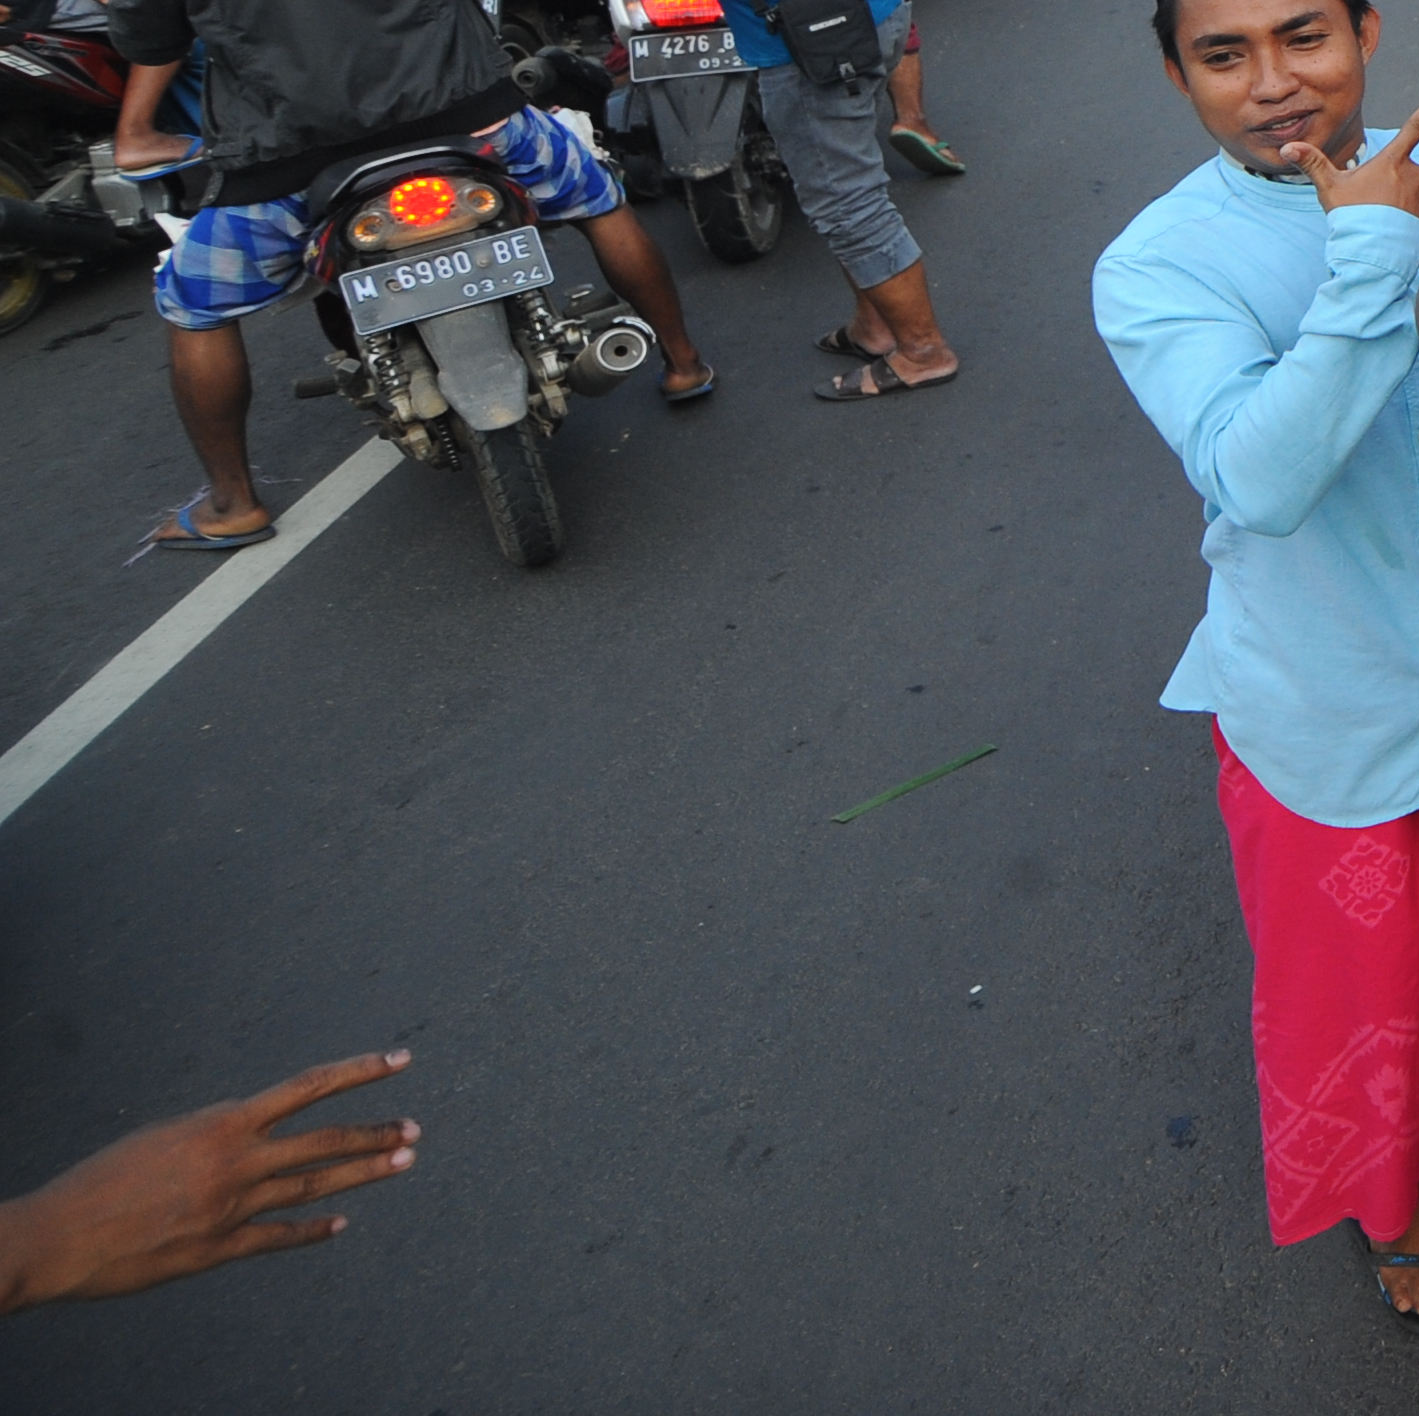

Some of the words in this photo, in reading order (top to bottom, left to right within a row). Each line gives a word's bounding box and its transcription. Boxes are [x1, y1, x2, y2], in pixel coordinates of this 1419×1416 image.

[634, 40, 649, 59] M
[661, 34, 710, 59] 4276
[352, 275, 380, 303] M
[395, 250, 472, 290] 6980
[491, 234, 532, 264] BE
